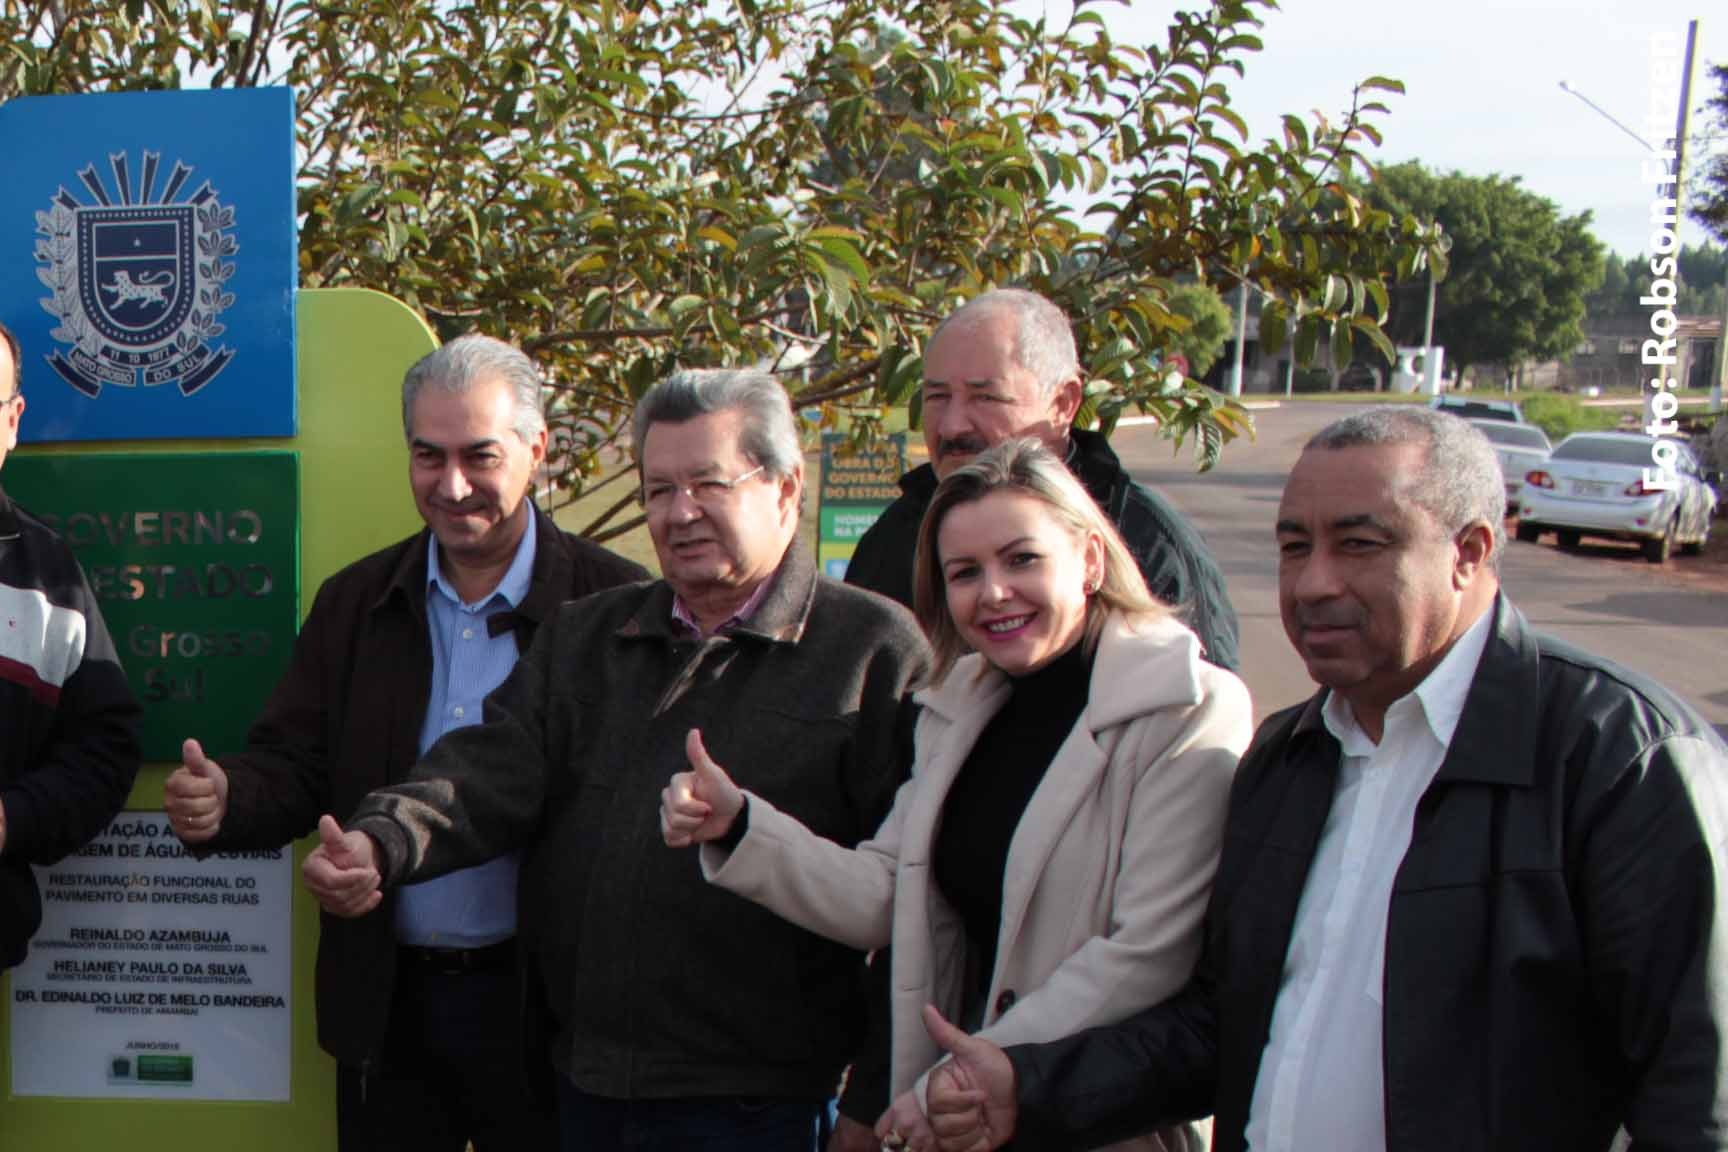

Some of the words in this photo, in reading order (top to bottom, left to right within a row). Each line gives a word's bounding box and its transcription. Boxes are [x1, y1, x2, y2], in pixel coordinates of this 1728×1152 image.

[176, 354, 201, 373] SUL
[94, 562, 274, 601] ESTADO
[128, 623, 270, 659] Grosso
[144, 667, 207, 704] Sul
[121, 844, 143, 858] DE
[48, 872, 150, 888] RESTAURAÇÃO
[153, 875, 232, 889] FUNCIONAL
[236, 876, 256, 889] DO
[45, 890, 125, 904] PAVIMENTO
[128, 891, 148, 904] EM
[151, 892, 219, 905] DIVERSAS
[222, 892, 260, 906] RUAS
[70, 927, 145, 942] REINALDO
[149, 929, 231, 944] AZAMBUJA
[130, 961, 179, 975] PAULO
[183, 962, 203, 976] DA
[207, 963, 248, 977] SILVA
[16, 989, 35, 1003] DR.
[41, 990, 112, 1005] EDINALDO
[114, 992, 145, 1006] LUIZ
[148, 993, 168, 1006] DE
[171, 994, 211, 1008] MELO
[213, 994, 286, 1009] BANDEIRA
